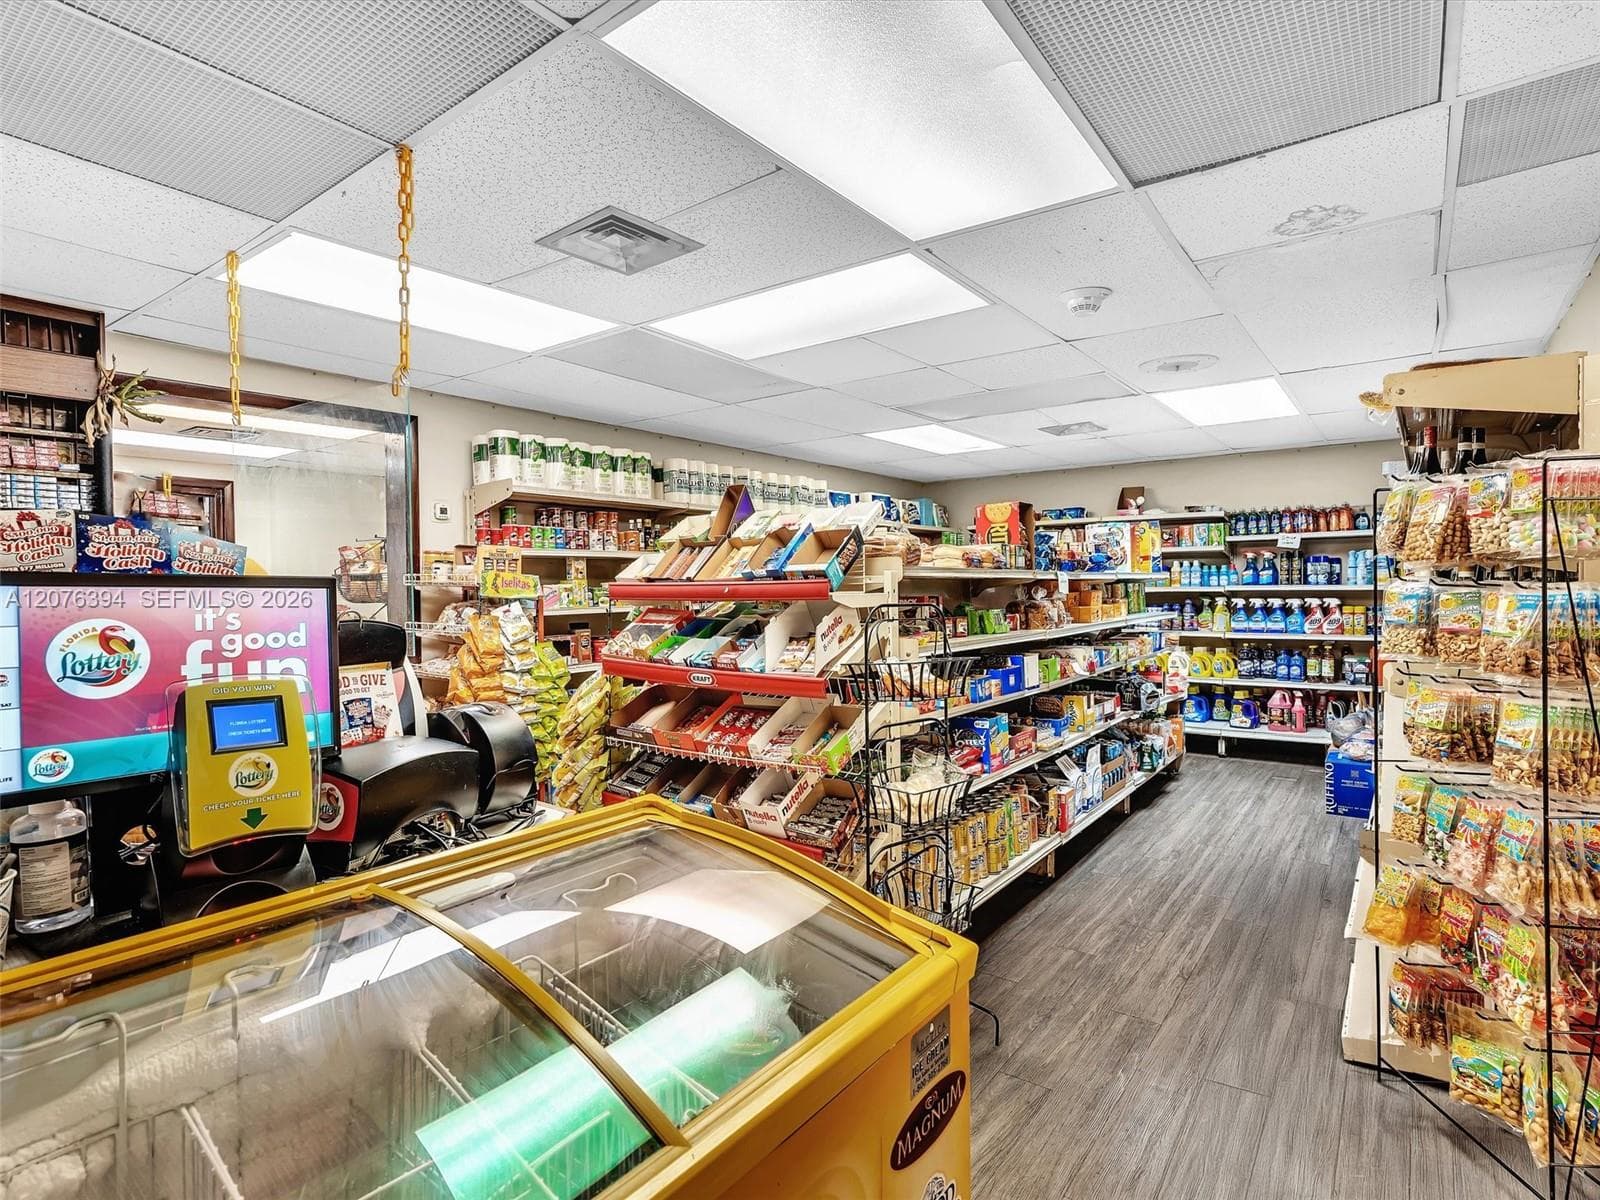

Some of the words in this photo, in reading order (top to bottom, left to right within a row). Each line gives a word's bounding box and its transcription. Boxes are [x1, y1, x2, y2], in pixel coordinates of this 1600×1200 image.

[0, 534, 73, 554] Holiday
[17, 545, 63, 563] Cash
[85, 543, 166, 561] Holiday
[103, 556, 153, 570] Cash
[194, 603, 242, 632] it's
[820, 616, 843, 642] nutella
[59, 626, 99, 653] FLORIDA
[220, 623, 307, 659] good
[56, 651, 142, 682] Lottery
[360, 674, 387, 686] GIVE
[707, 744, 733, 757] KitKat
[234, 769, 273, 788] Lottery
[1324, 762, 1337, 814] RUFFINO
[203, 802, 232, 812] CHECK
[233, 798, 254, 806] YOUR
[255, 794, 280, 803] TICKET
[281, 790, 300, 798] HERE
[782, 780, 809, 816] nutella
[743, 809, 777, 821] nutella
[912, 1058, 924, 1078] ICE
[926, 1035, 949, 1065] CREAM
[896, 1076, 963, 1165] MAGNUM
